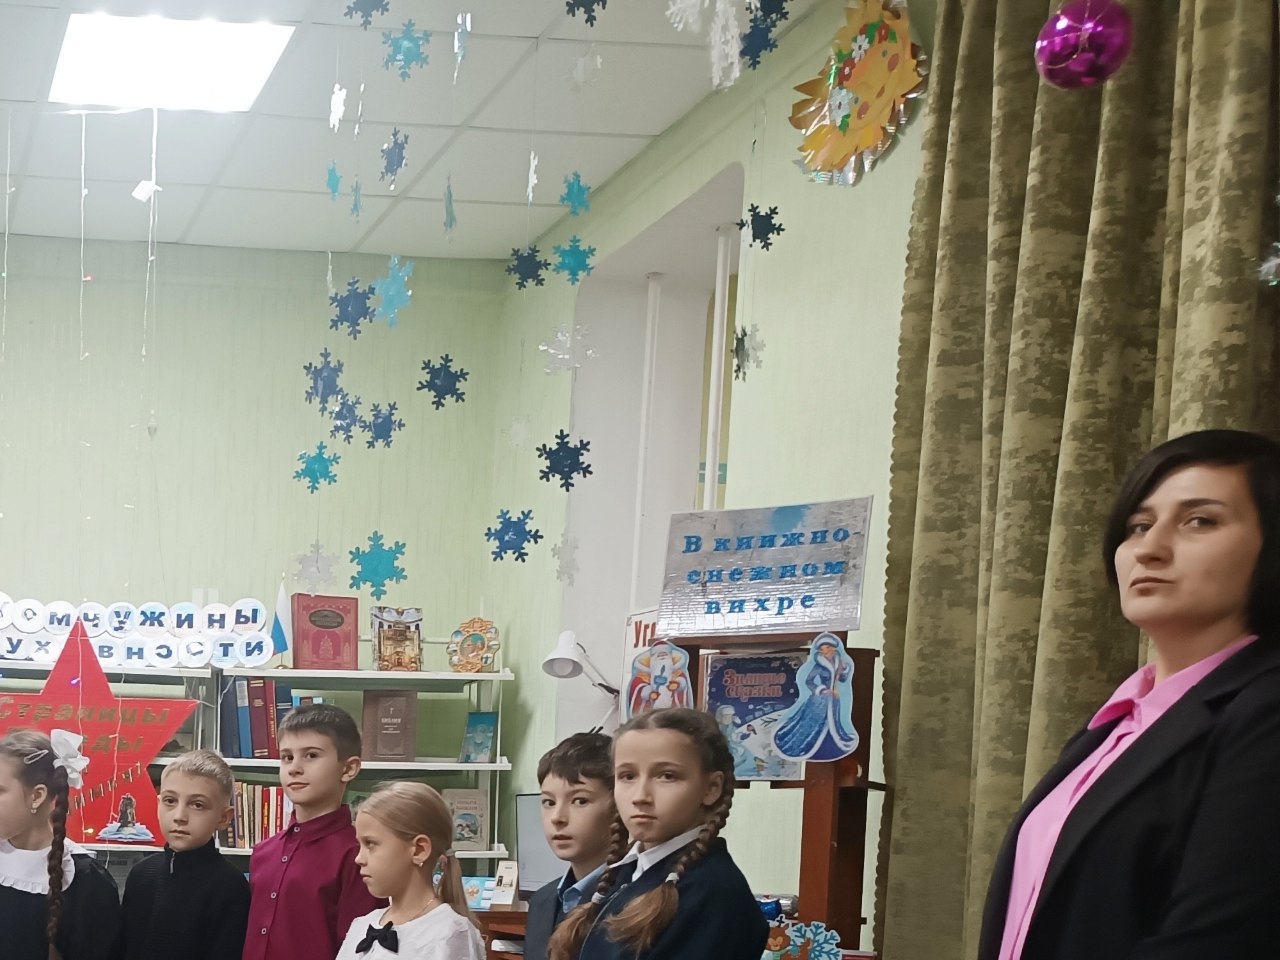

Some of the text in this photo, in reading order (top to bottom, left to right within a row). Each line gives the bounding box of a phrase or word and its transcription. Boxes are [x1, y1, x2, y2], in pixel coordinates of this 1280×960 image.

[682, 527, 861, 553] В книжно-
[686, 559, 846, 585] снежном
[704, 593, 815, 616] вихре
